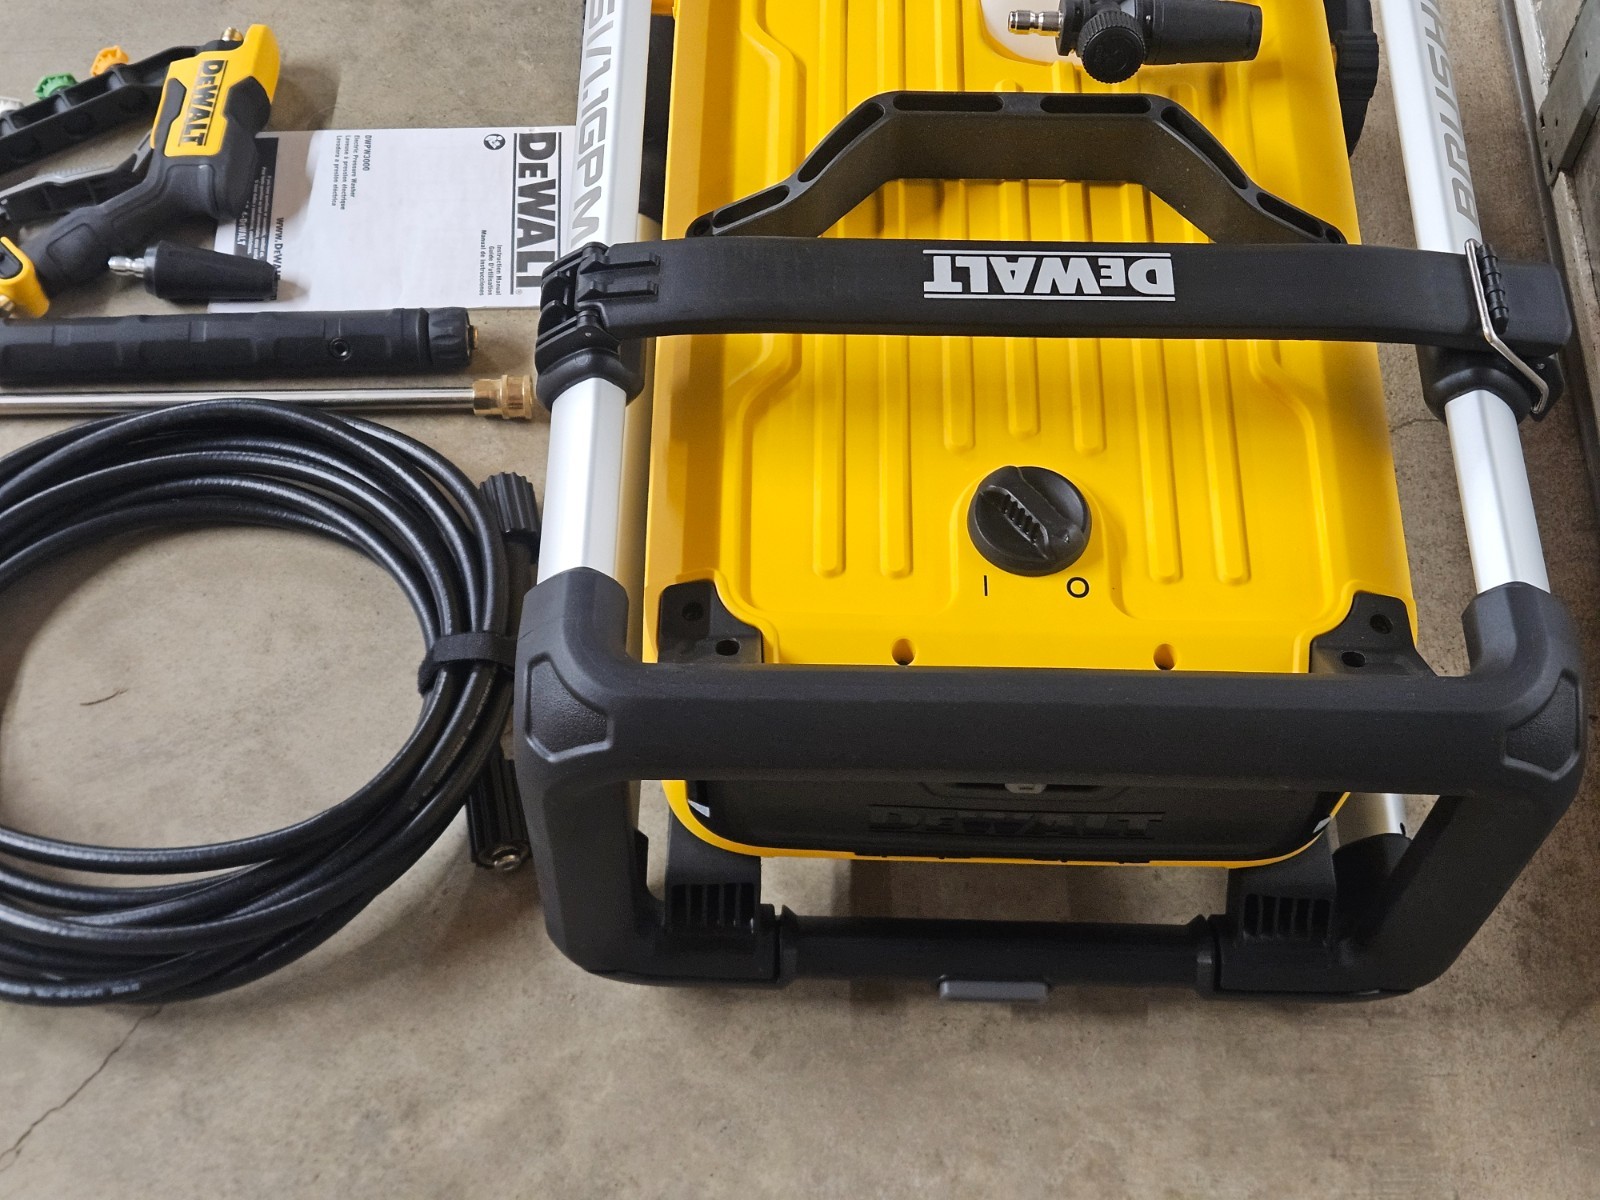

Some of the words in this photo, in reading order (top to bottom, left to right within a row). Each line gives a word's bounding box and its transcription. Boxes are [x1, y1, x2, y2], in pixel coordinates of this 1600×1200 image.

[182, 59, 226, 147] DEWALT
[1421, 0, 1479, 231] BRUSH
[353, 134, 361, 154] Electric
[362, 134, 373, 172] DWPW3000
[351, 154, 359, 177] Pressure
[350, 178, 358, 198] Washer
[923, 255, 1176, 296] DEWALT
